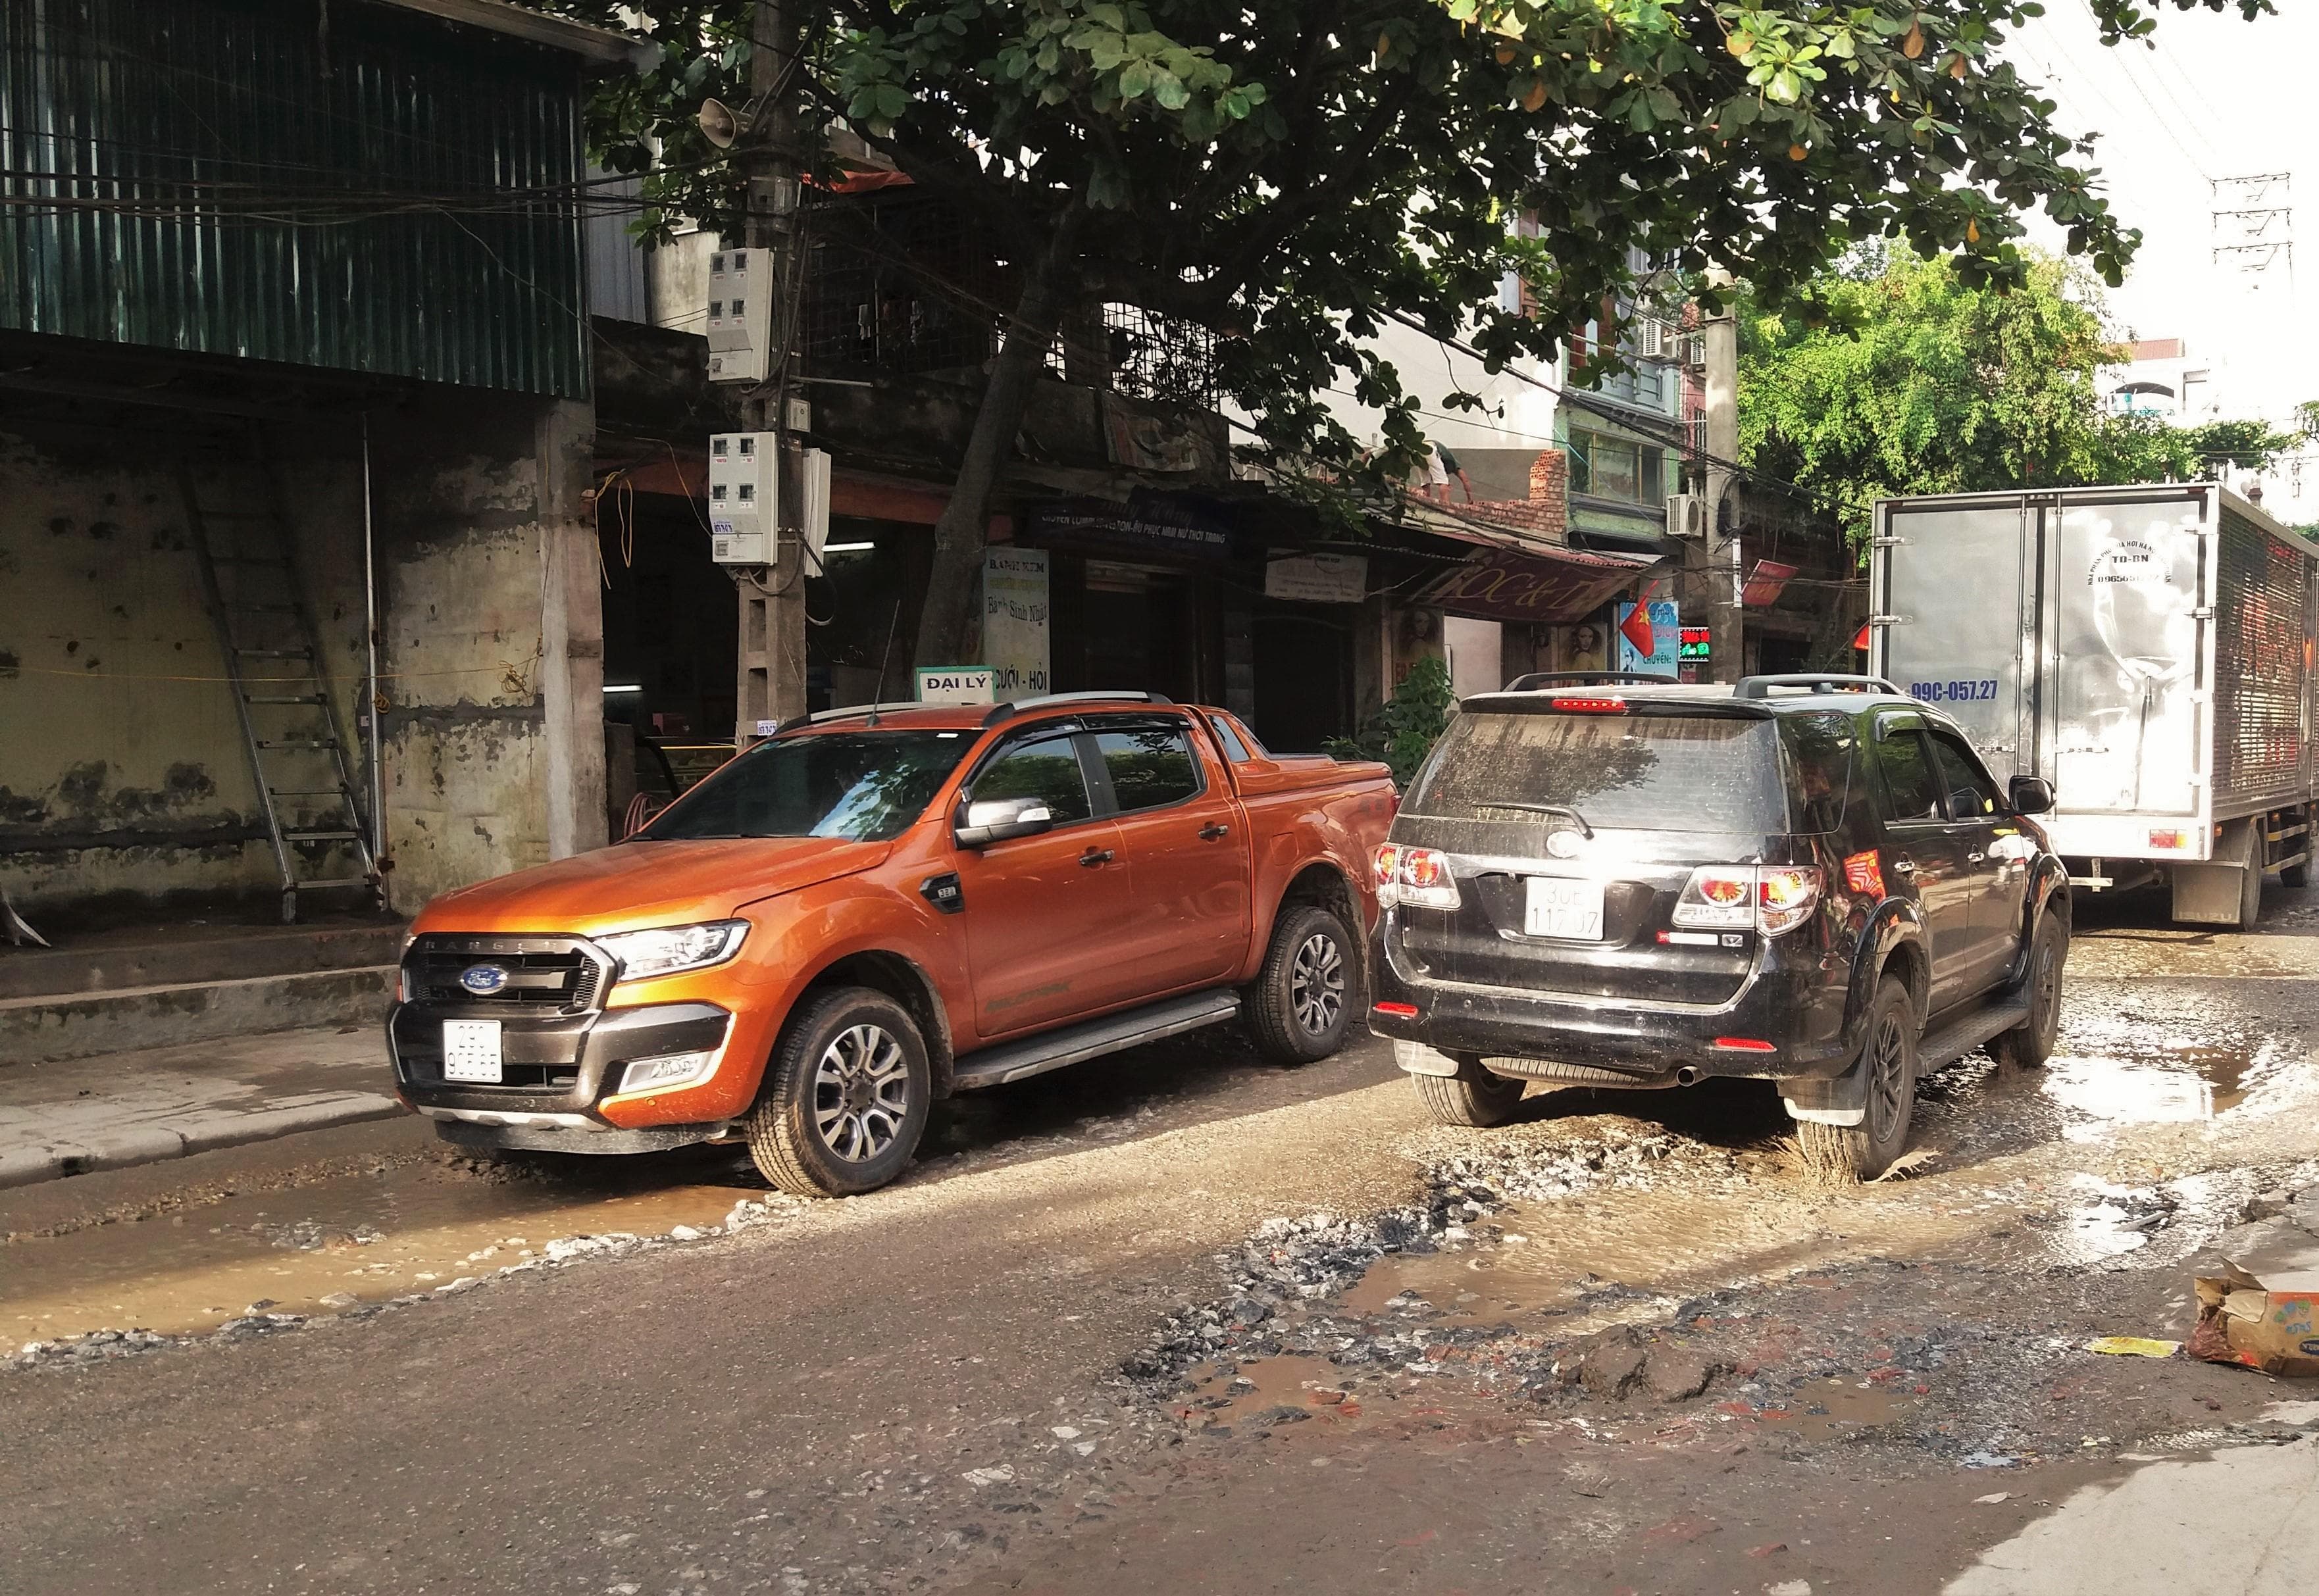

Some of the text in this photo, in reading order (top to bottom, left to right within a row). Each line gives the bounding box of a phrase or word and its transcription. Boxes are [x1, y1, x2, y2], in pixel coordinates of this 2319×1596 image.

[927, 674, 987, 692] ĐẠI LÝ
[1029, 662, 1048, 691] HỎI
[1911, 680, 1998, 702] 99C-057.27
[467, 970, 496, 987] Ford
